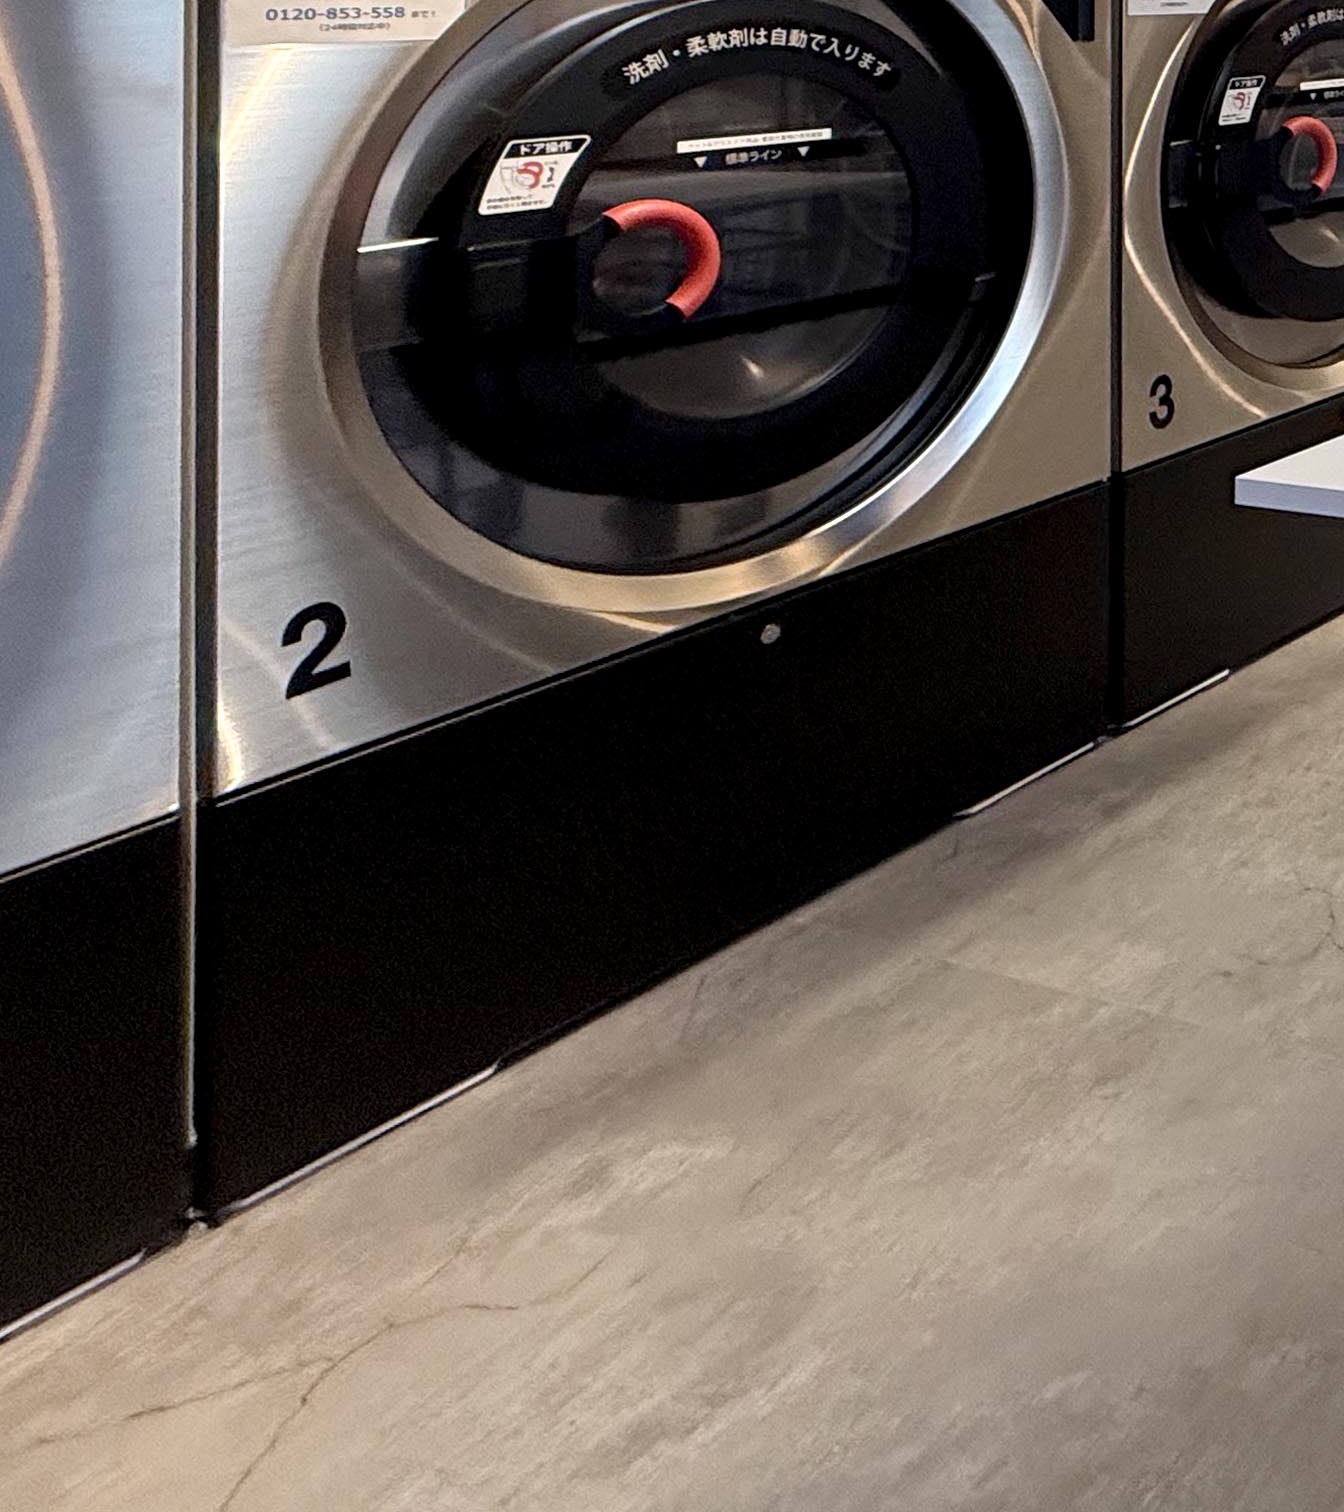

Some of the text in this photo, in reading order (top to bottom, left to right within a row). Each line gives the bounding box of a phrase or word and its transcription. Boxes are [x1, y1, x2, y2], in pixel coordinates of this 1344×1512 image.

[264, 5, 406, 23] 0120-853-558
[621, 24, 893, 86] 洗剤・柔軟剤は自動で入ります
[1148, 373, 1176, 429] 3
[280, 600, 352, 701] 2
